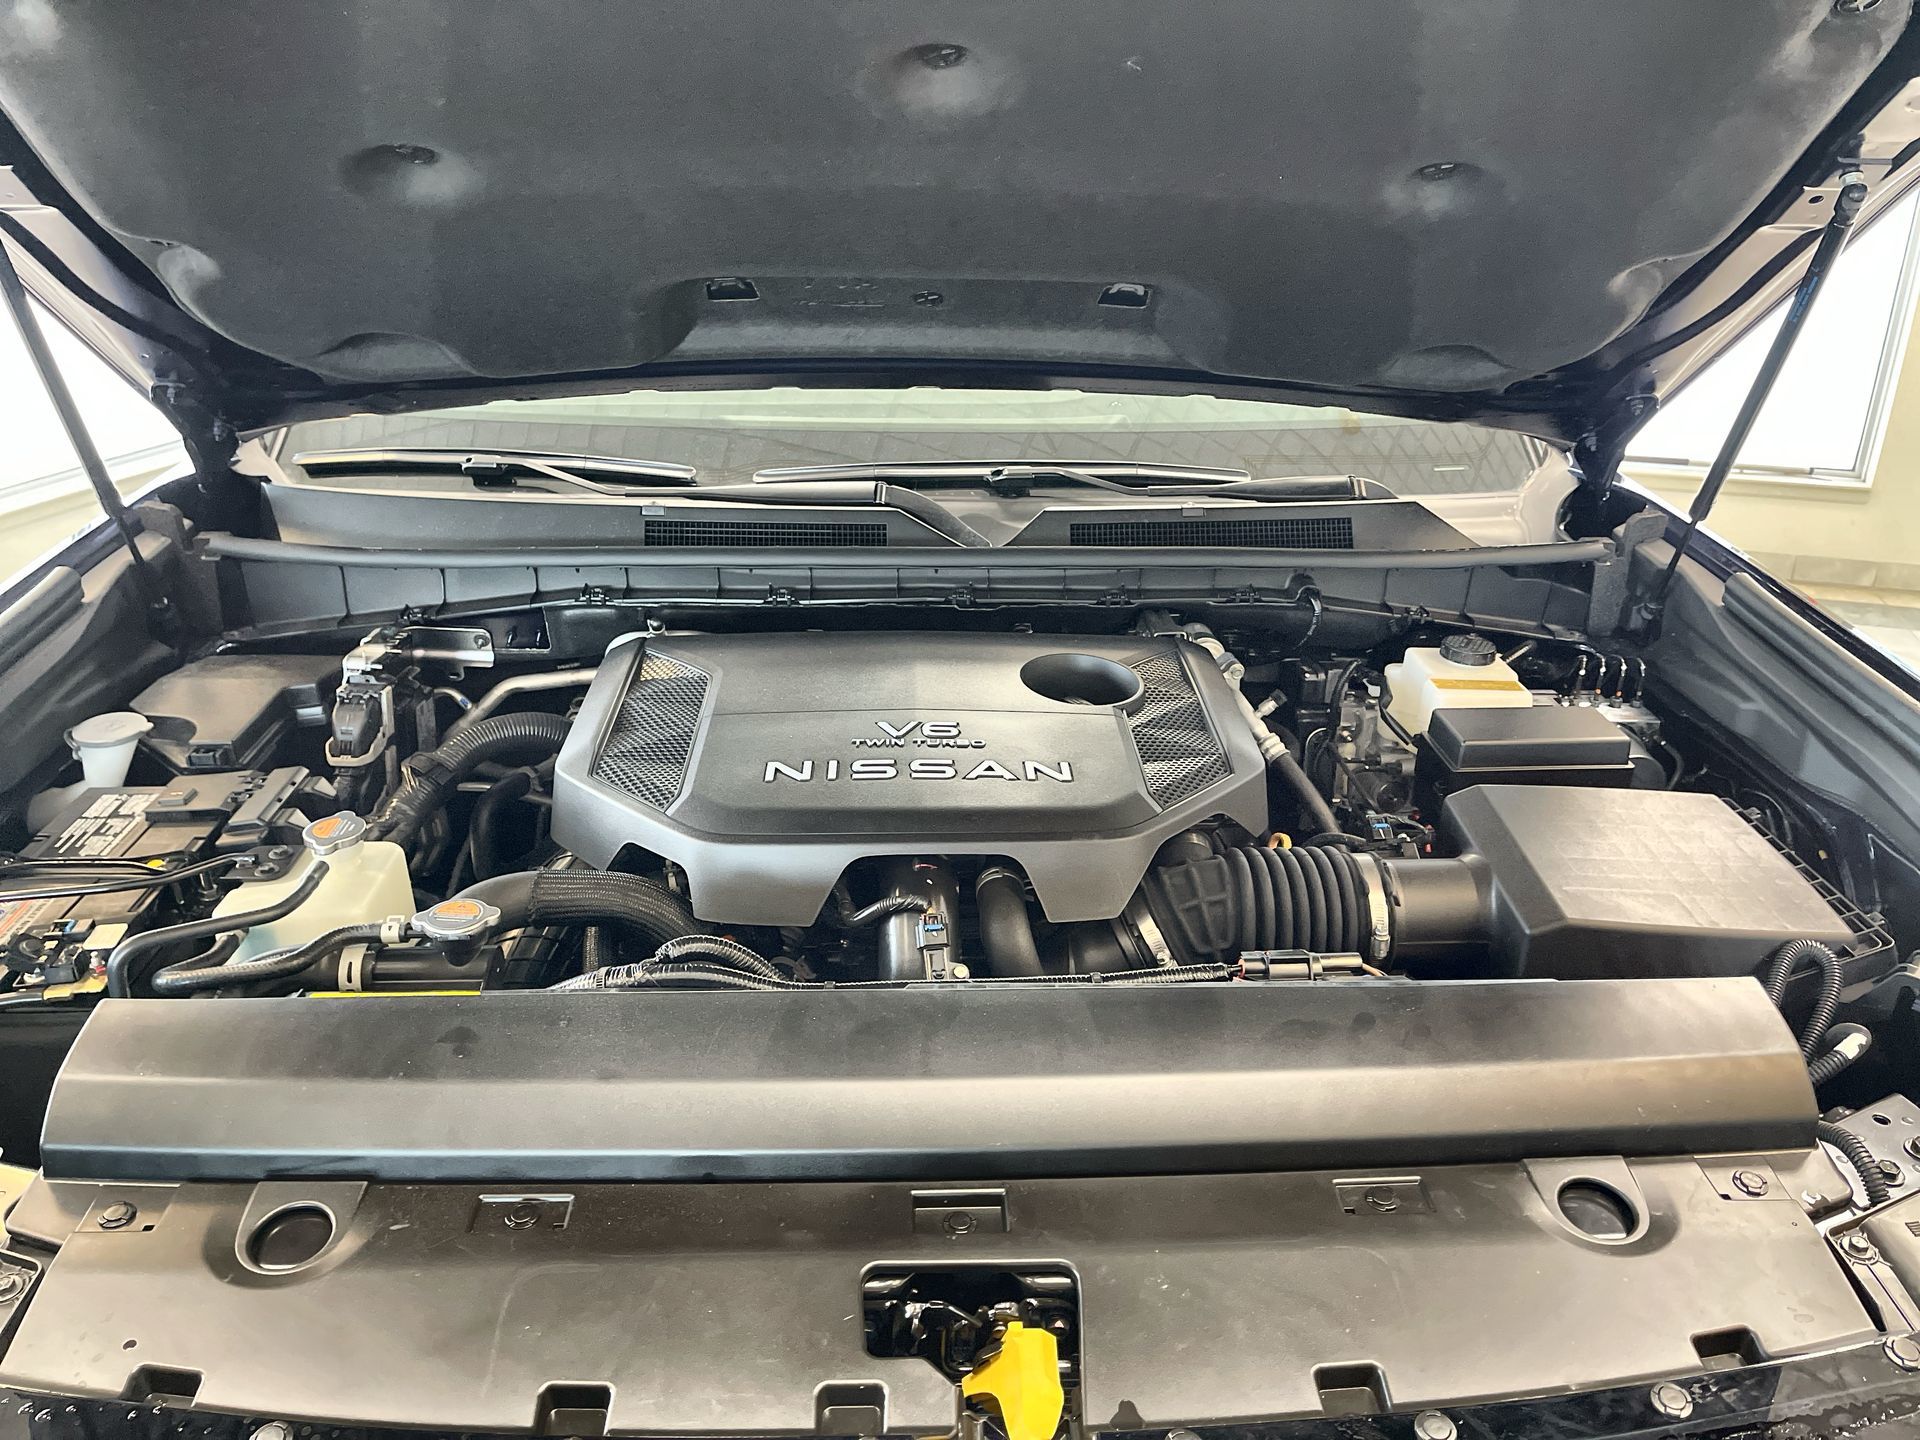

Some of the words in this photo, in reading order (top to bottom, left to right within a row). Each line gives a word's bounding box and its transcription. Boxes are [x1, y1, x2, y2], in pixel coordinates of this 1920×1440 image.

[875, 721, 961, 738] V6
[851, 738, 905, 748] TWIN
[912, 738, 986, 748] TURBO
[764, 759, 1074, 782] NISSAN
